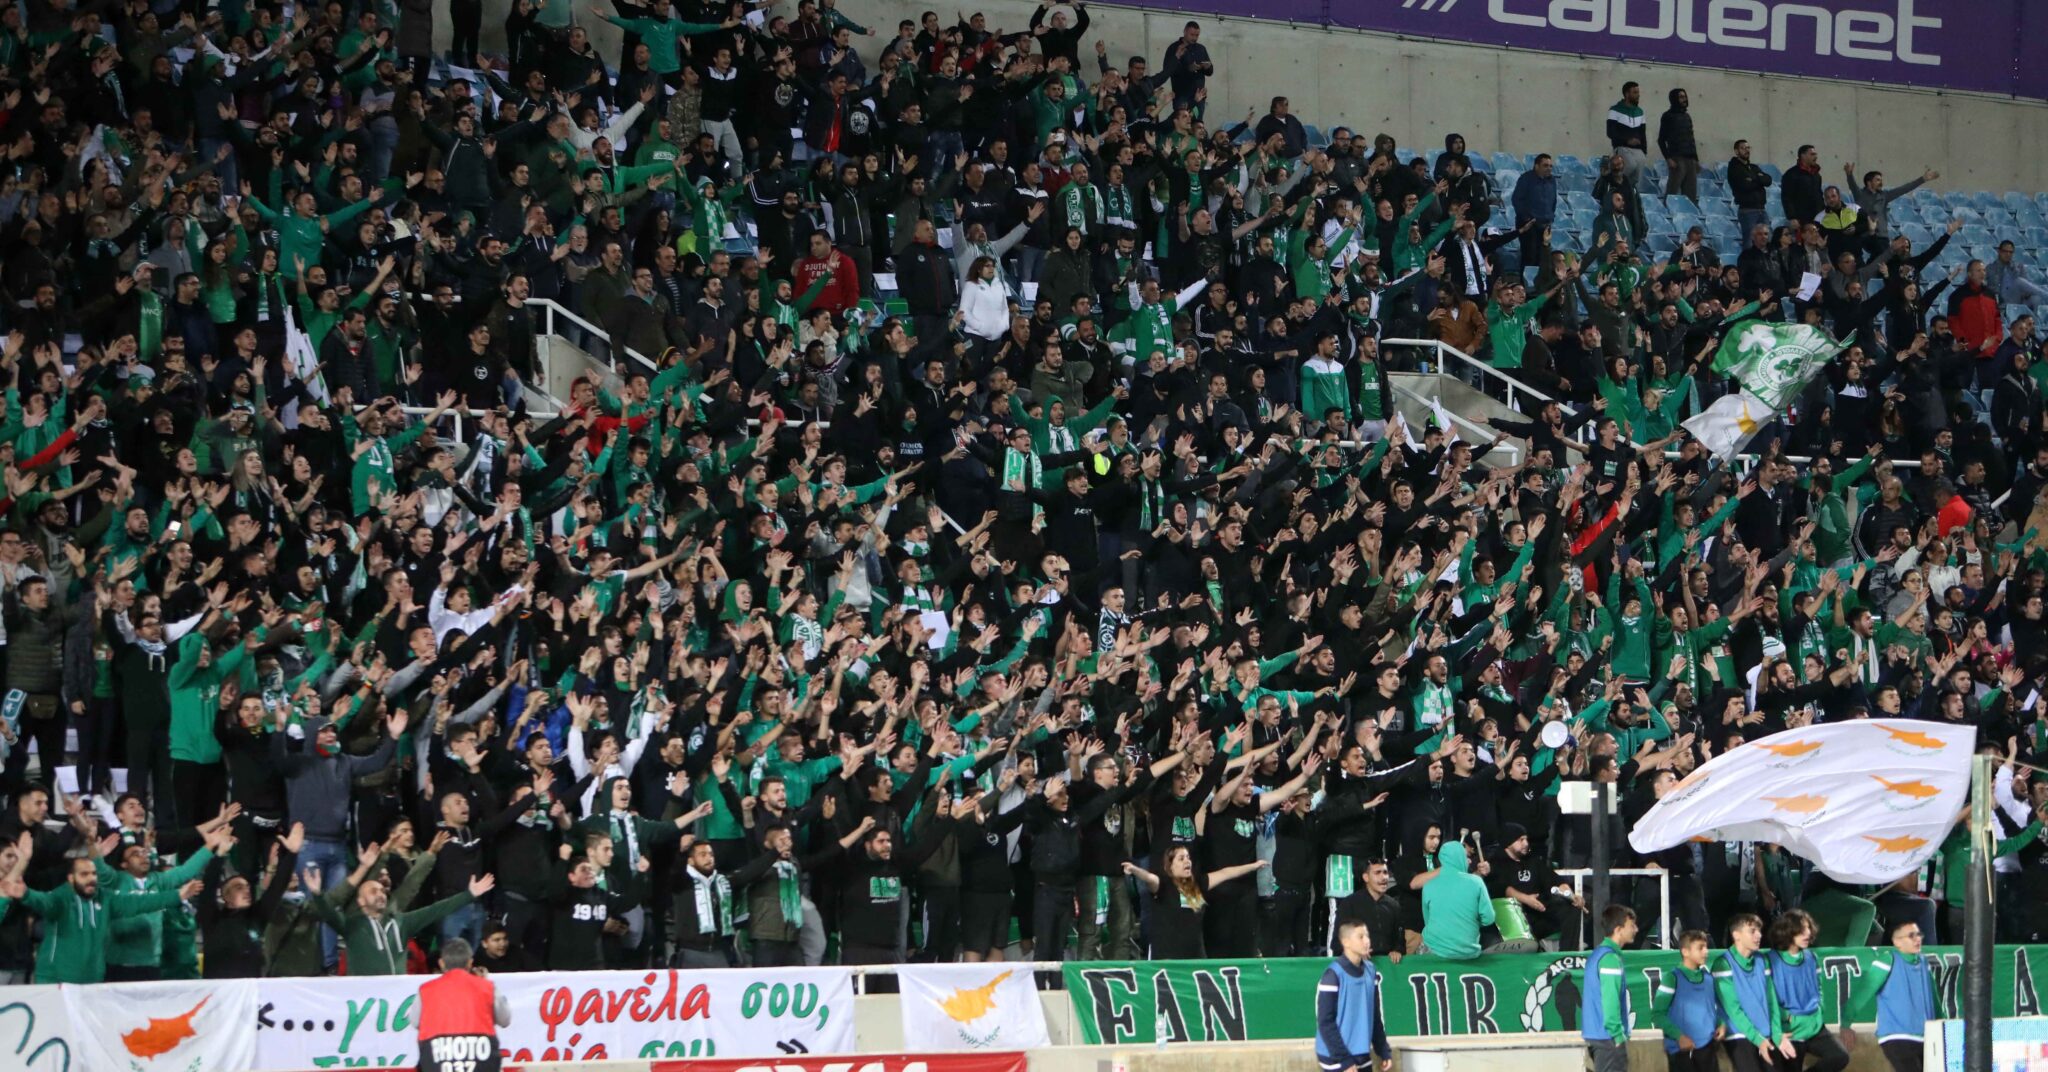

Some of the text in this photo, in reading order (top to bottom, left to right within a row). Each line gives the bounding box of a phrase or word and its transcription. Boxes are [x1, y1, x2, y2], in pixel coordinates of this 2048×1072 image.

[540, 969, 711, 1042] φανέλα
[741, 981, 830, 1032] σου,
[432, 1035, 492, 1063] PHOTO
